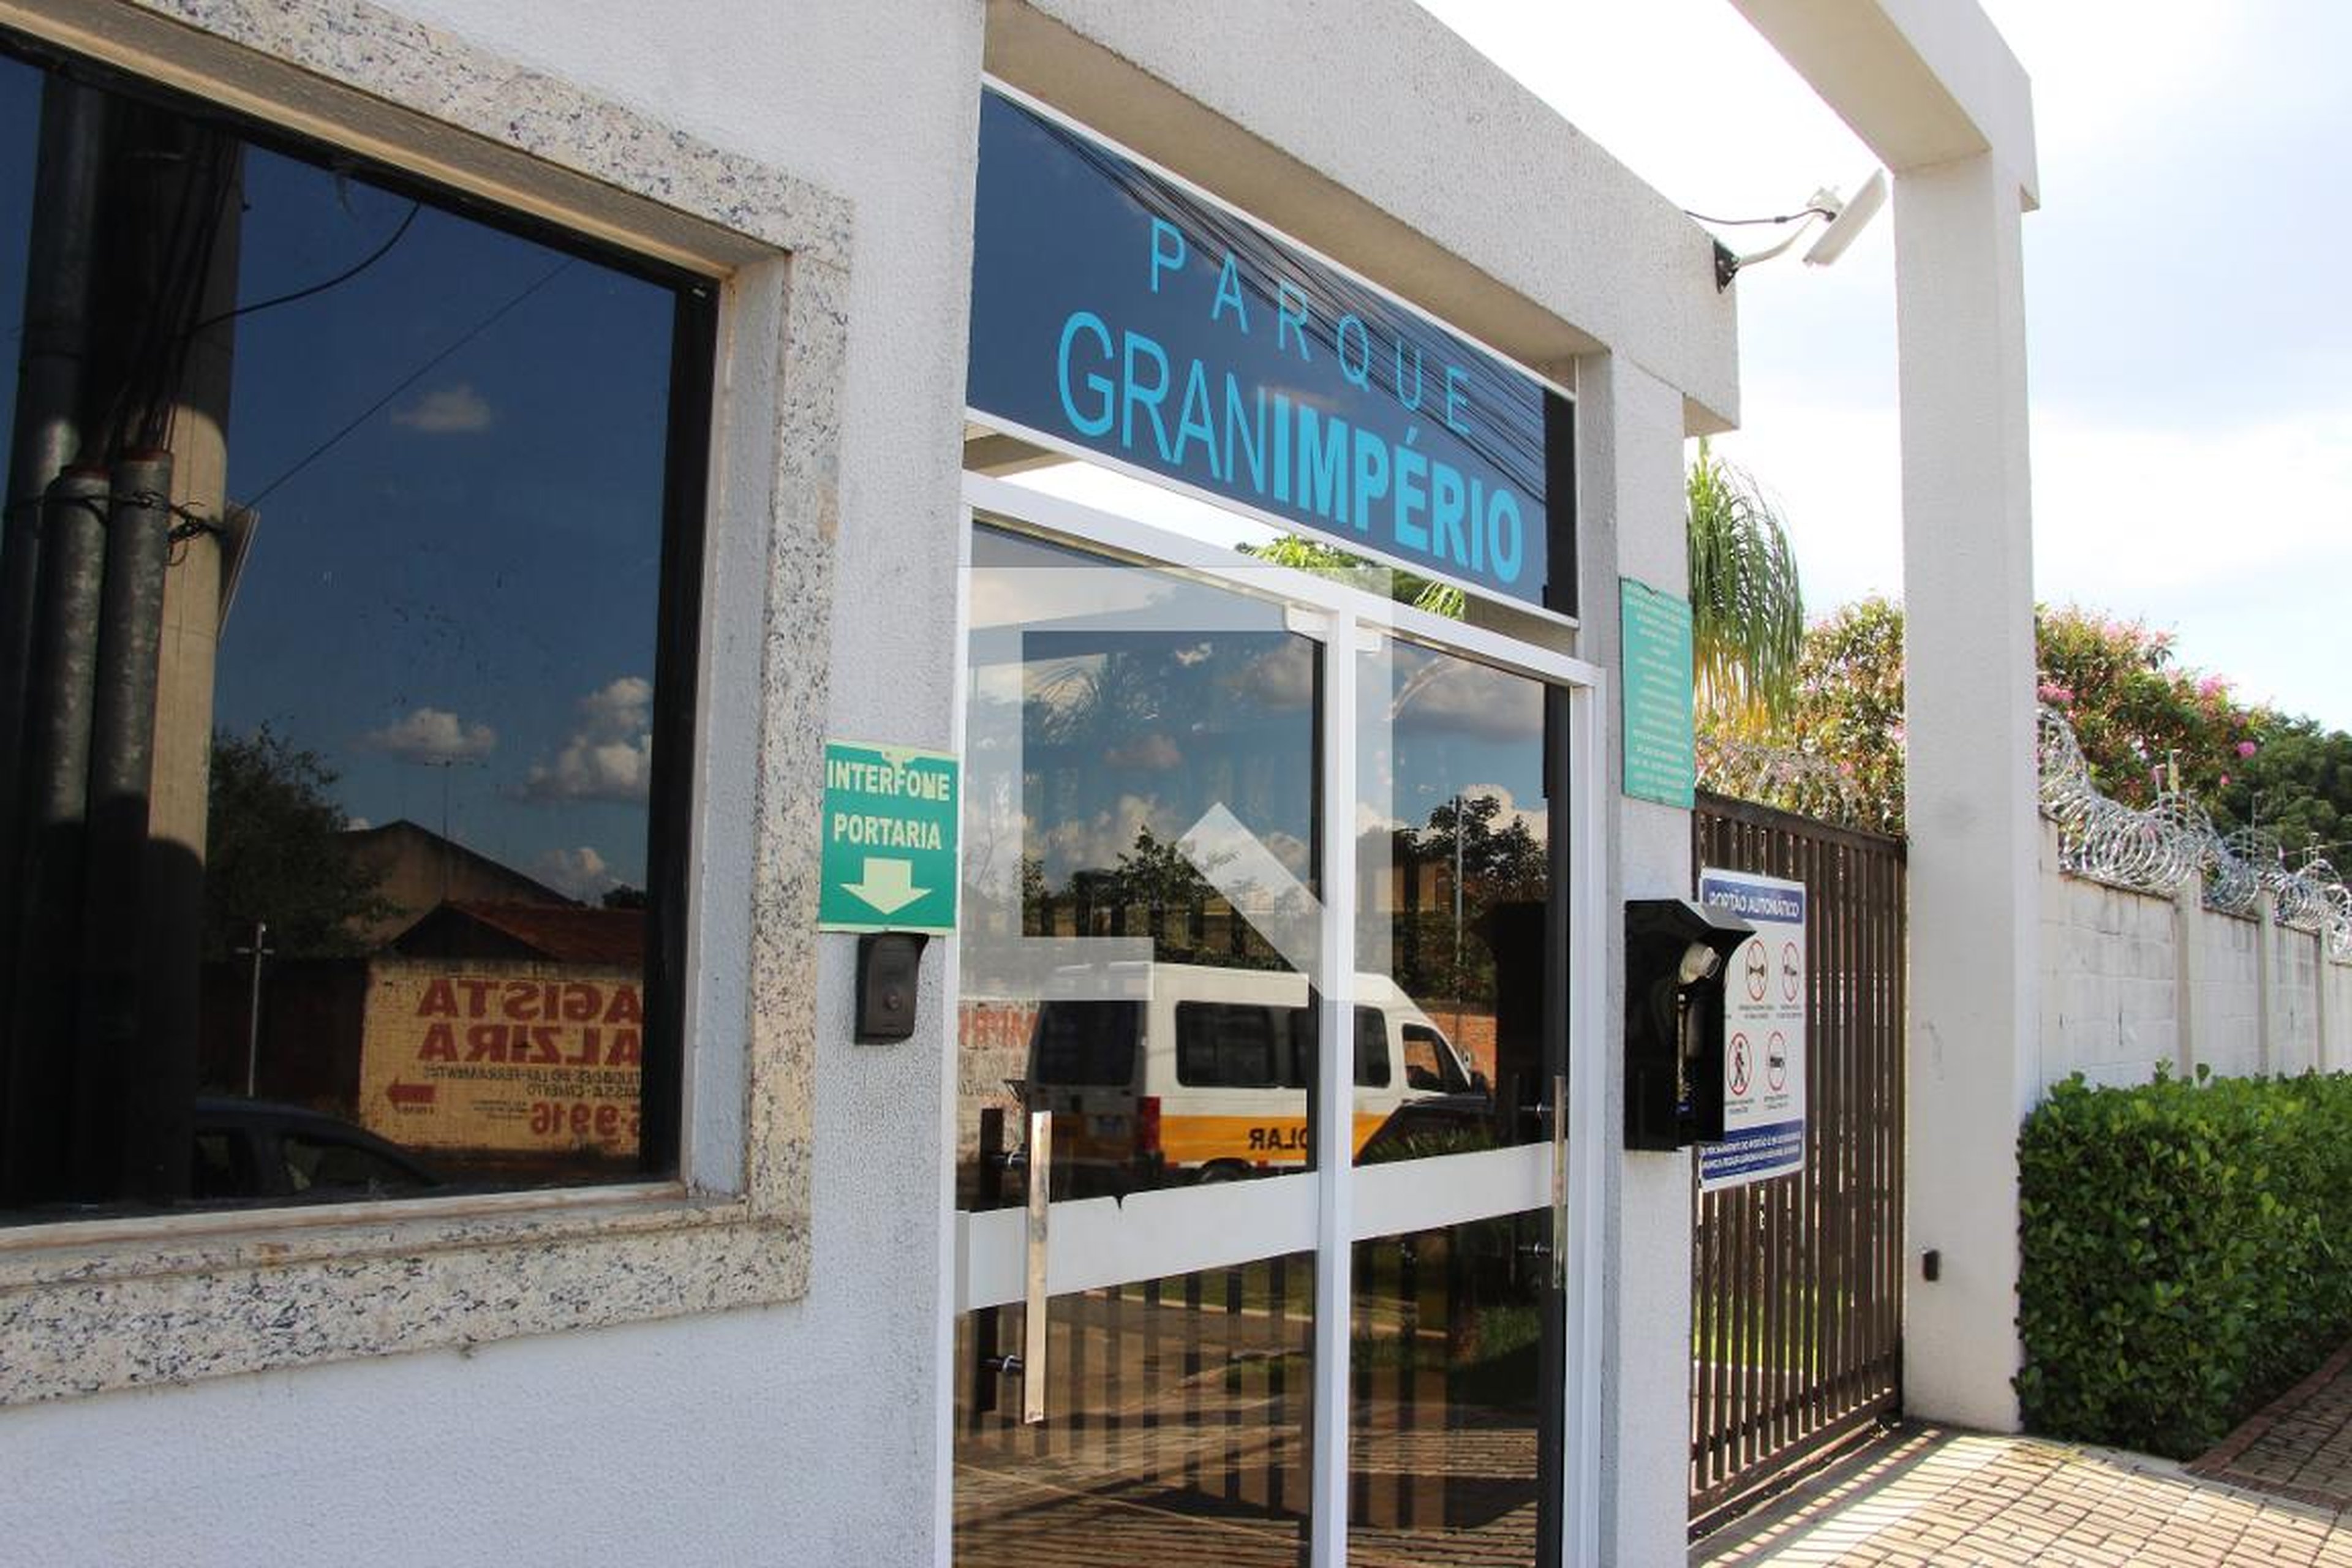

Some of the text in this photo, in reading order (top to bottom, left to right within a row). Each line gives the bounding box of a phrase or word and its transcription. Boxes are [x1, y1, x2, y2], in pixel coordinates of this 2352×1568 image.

[1149, 218, 1472, 432] PARQUE
[827, 760, 950, 801] INTERFONE
[834, 813, 942, 850] PORTARIA
